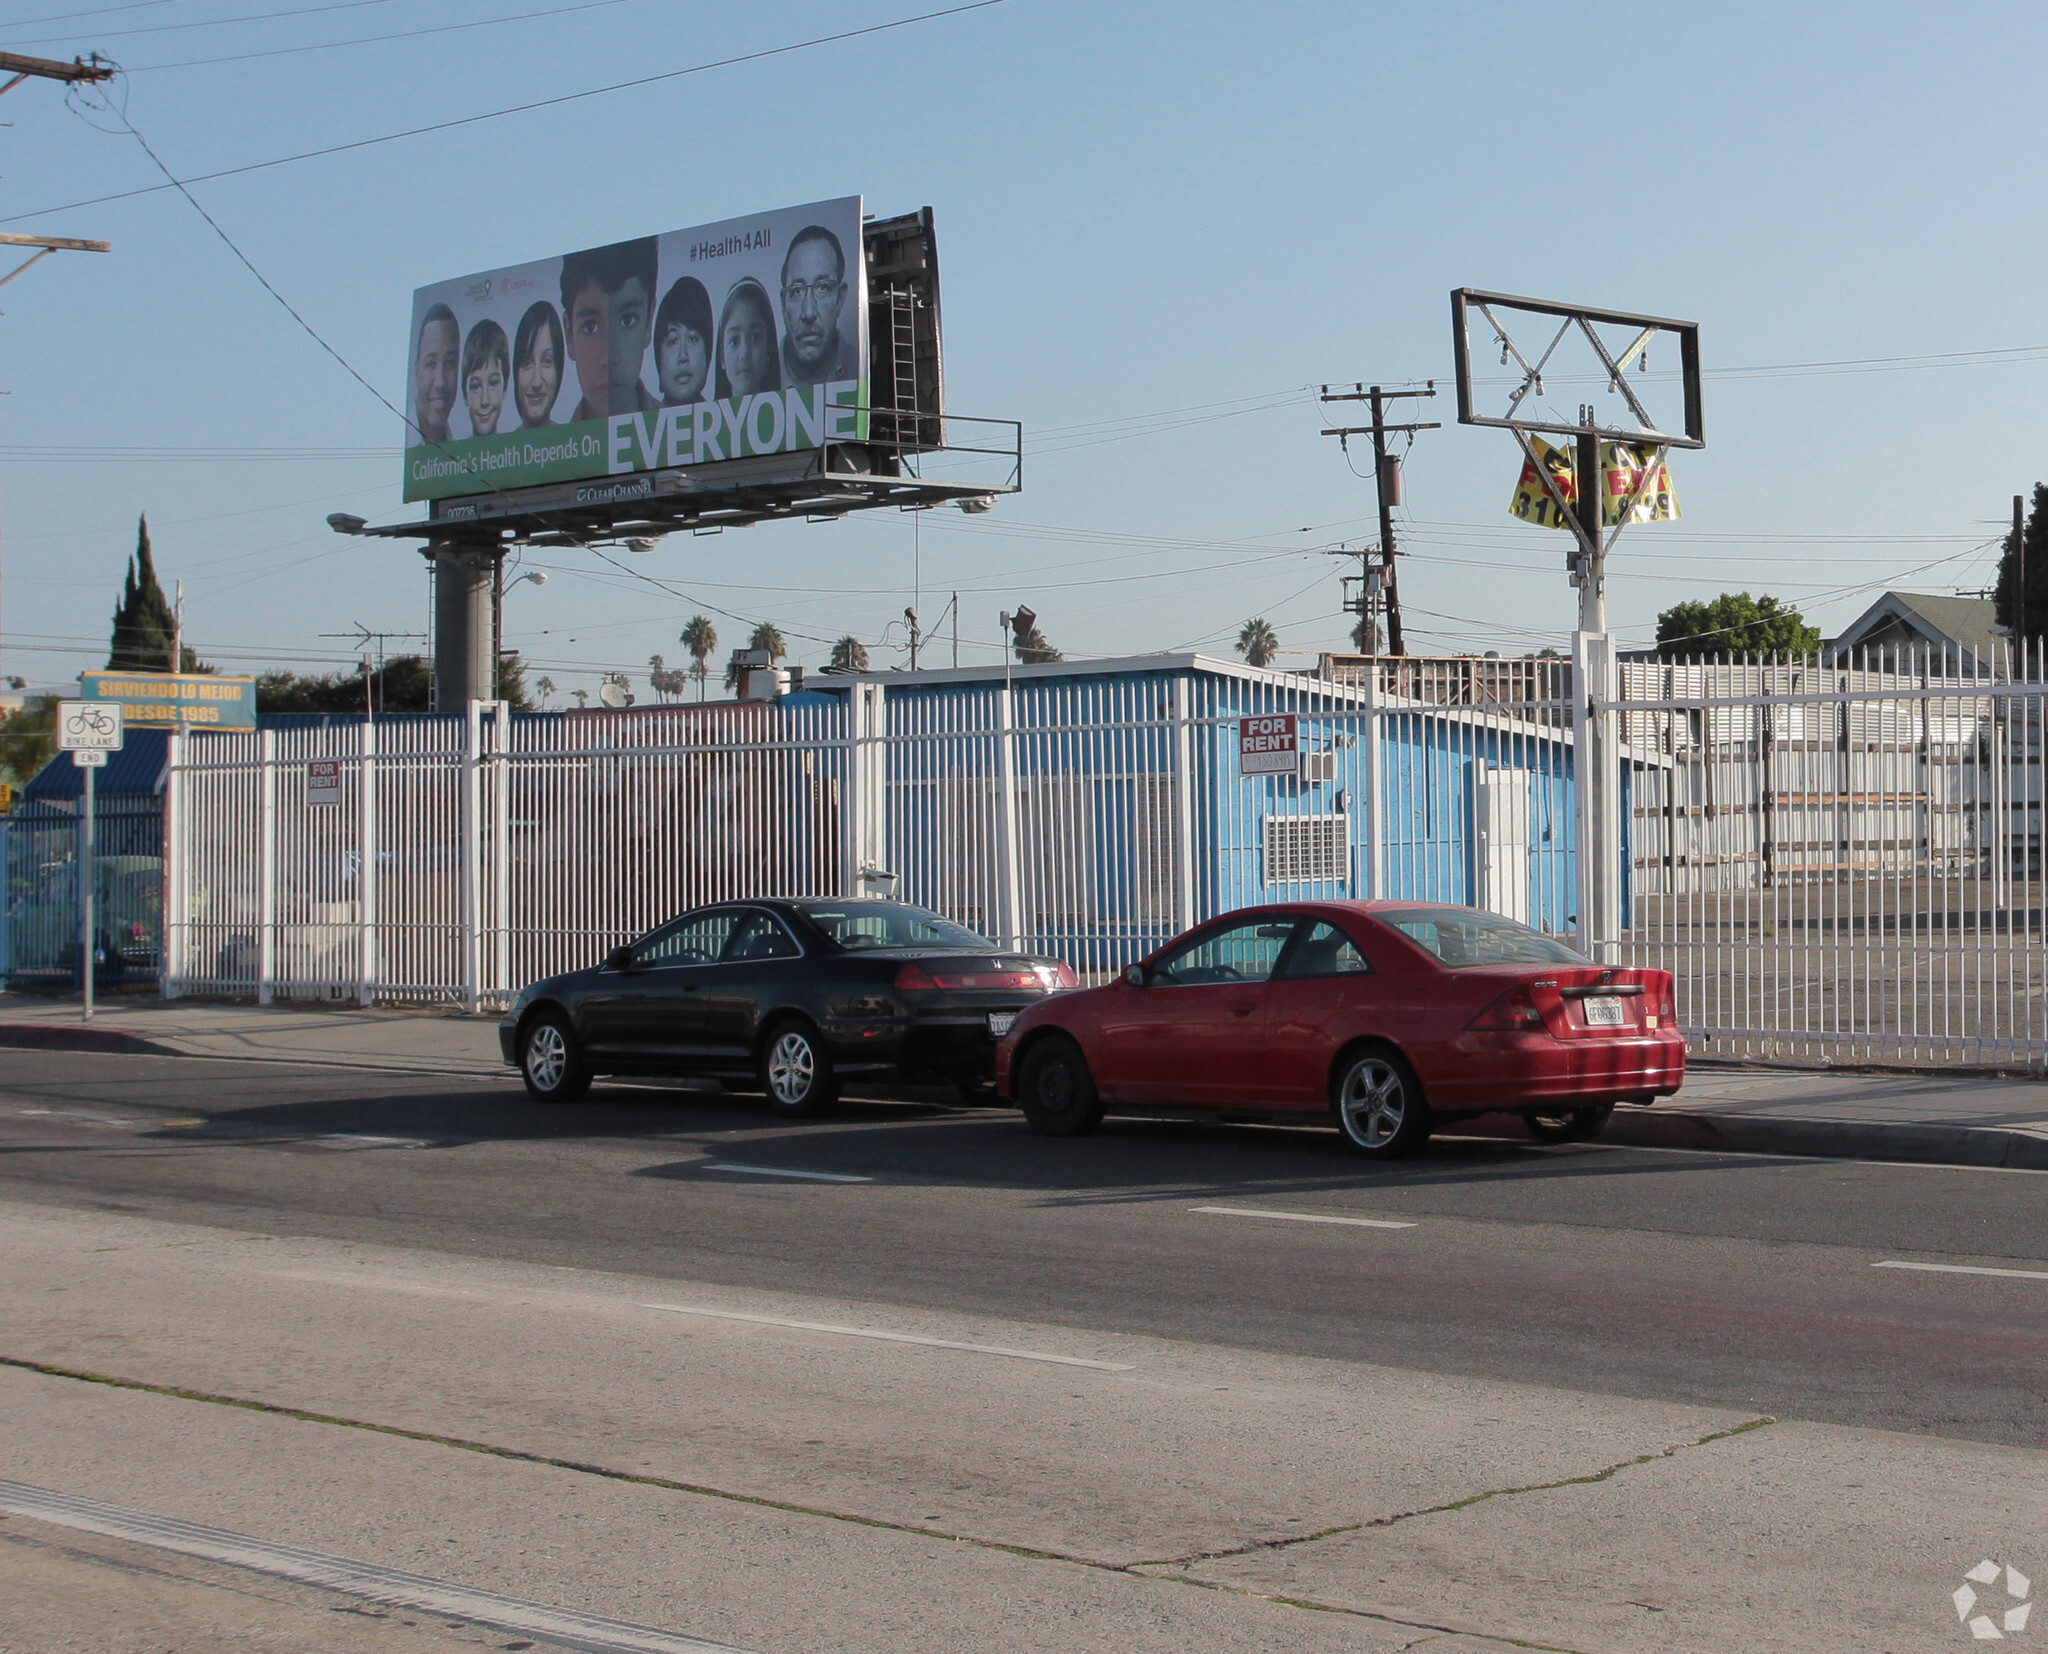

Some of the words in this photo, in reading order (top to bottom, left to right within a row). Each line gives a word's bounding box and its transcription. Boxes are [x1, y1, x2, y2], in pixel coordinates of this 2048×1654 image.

[608, 378, 858, 475] EVERYONE
[412, 453, 478, 481] California's
[480, 446, 521, 471] Health
[524, 437, 579, 469] Depends
[581, 435, 601, 457] On
[98, 680, 179, 698] SIRVIENDO
[180, 683, 196, 699] LO
[123, 704, 177, 720] DESDE
[180, 706, 219, 722] 1985
[1248, 718, 1286, 735] FOR
[66, 737, 88, 746] BIKE
[90, 737, 114, 746] LANE
[1242, 734, 1293, 752] RENT
[81, 753, 99, 762] END
[313, 763, 334, 775] FOR
[310, 775, 337, 787] RENT
